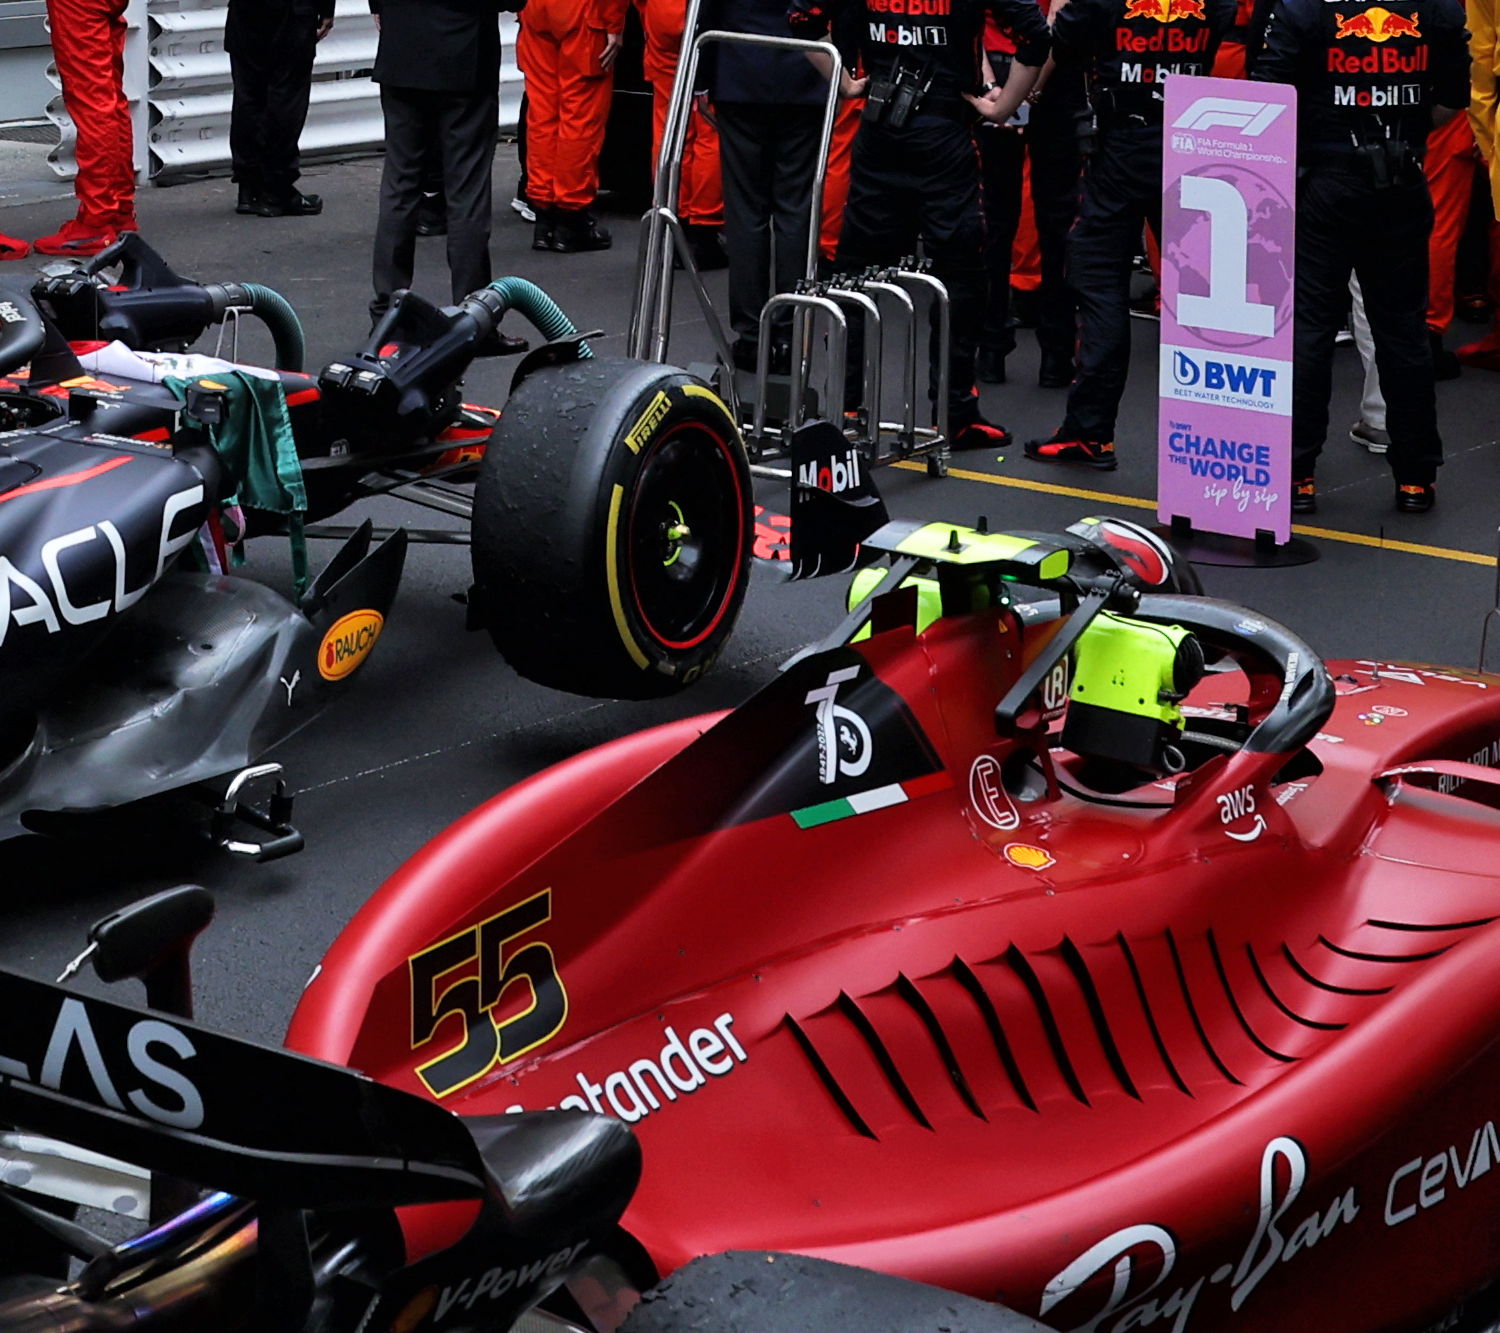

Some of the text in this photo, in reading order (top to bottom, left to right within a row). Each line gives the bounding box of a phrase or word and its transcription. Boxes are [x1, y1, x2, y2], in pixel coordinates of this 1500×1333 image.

[870, 23, 923, 46] Mobil
[1116, 27, 1210, 52] Red Bull
[1121, 62, 1180, 84] Mobil
[1327, 44, 1429, 73] Red Bull
[1334, 85, 1399, 107] Mobil
[1197, 146, 1223, 157] World
[1198, 137, 1212, 146] FIA
[1212, 140, 1248, 152] Formula
[1177, 175, 1275, 339] 1
[1205, 360, 1276, 398] BWT
[1174, 388, 1275, 410] BEST WATER TECHNOLOGY
[623, 390, 673, 455] PIRELLI
[1168, 432, 1270, 467] CHANGE
[799, 448, 861, 494] Mobil
[1168, 454, 1271, 487] THE WORLD
[1203, 475, 1279, 512] sip by sip
[335, 622, 378, 664] RAUCH
[1215, 784, 1255, 825] aws
[409, 885, 570, 1099] 55
[1040, 1136, 1360, 1333] Ray-Ban
[433, 1239, 590, 1324] V-Power
